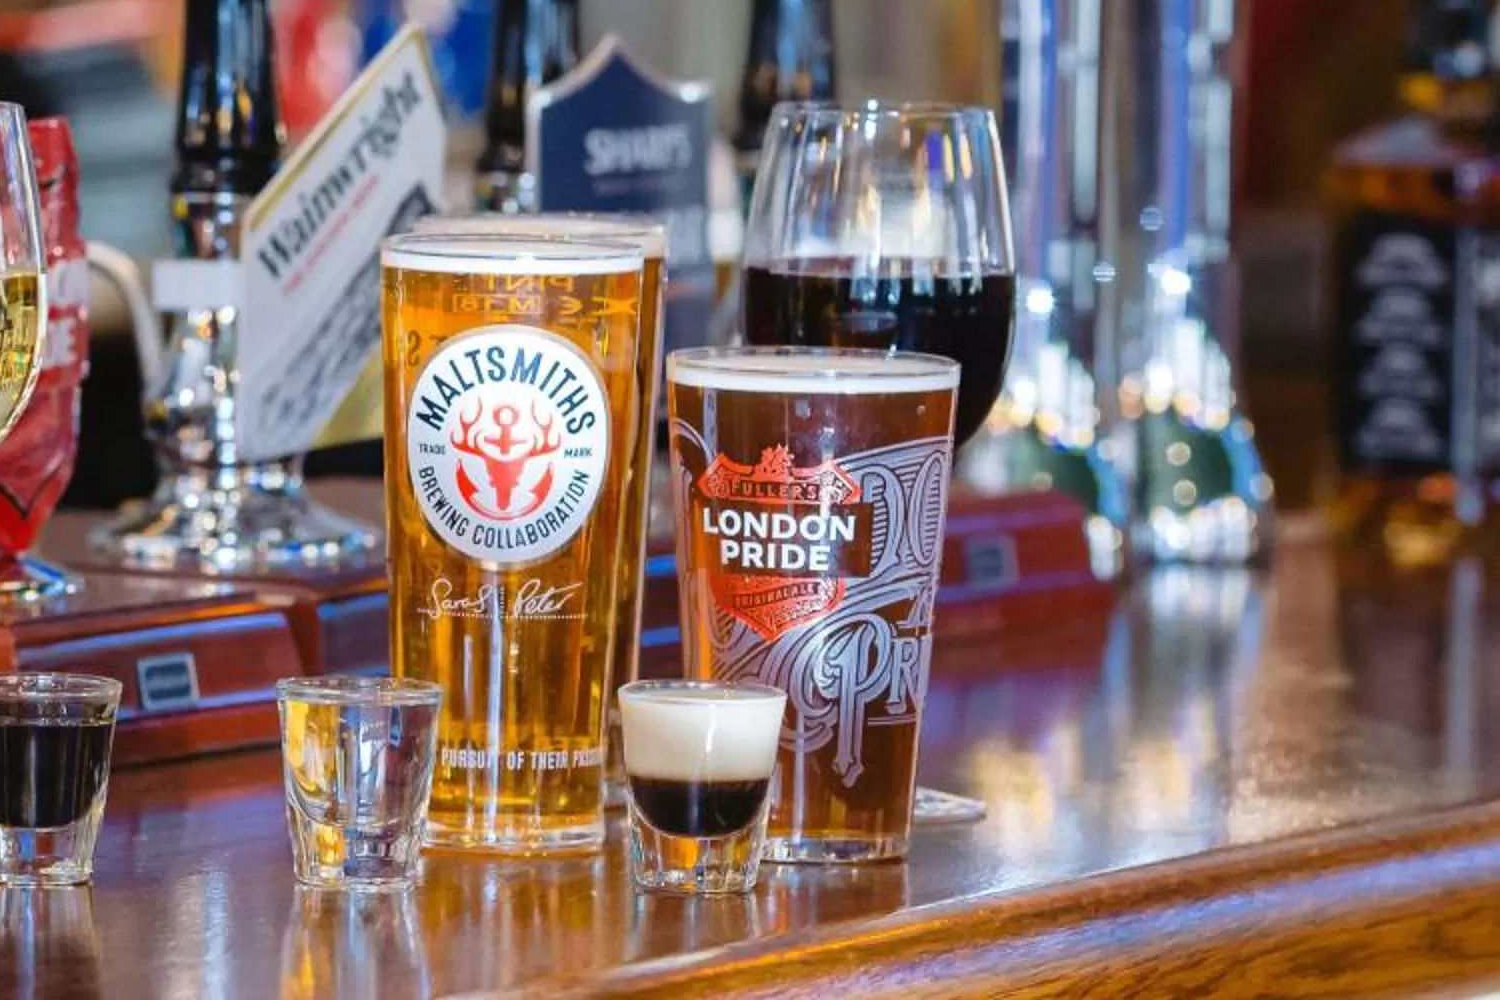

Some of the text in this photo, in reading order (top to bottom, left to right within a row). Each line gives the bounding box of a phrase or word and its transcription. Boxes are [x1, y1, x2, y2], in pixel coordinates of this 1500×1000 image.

[415, 346, 596, 436] MALTSMITHS
[419, 443, 592, 459] TRADE MARK
[419, 465, 591, 550] BREWING COLLABORATION
[703, 507, 857, 542] LONDON
[720, 539, 831, 571] PRIDE
[507, 752, 525, 770] OF
[531, 751, 568, 770] THEIR
